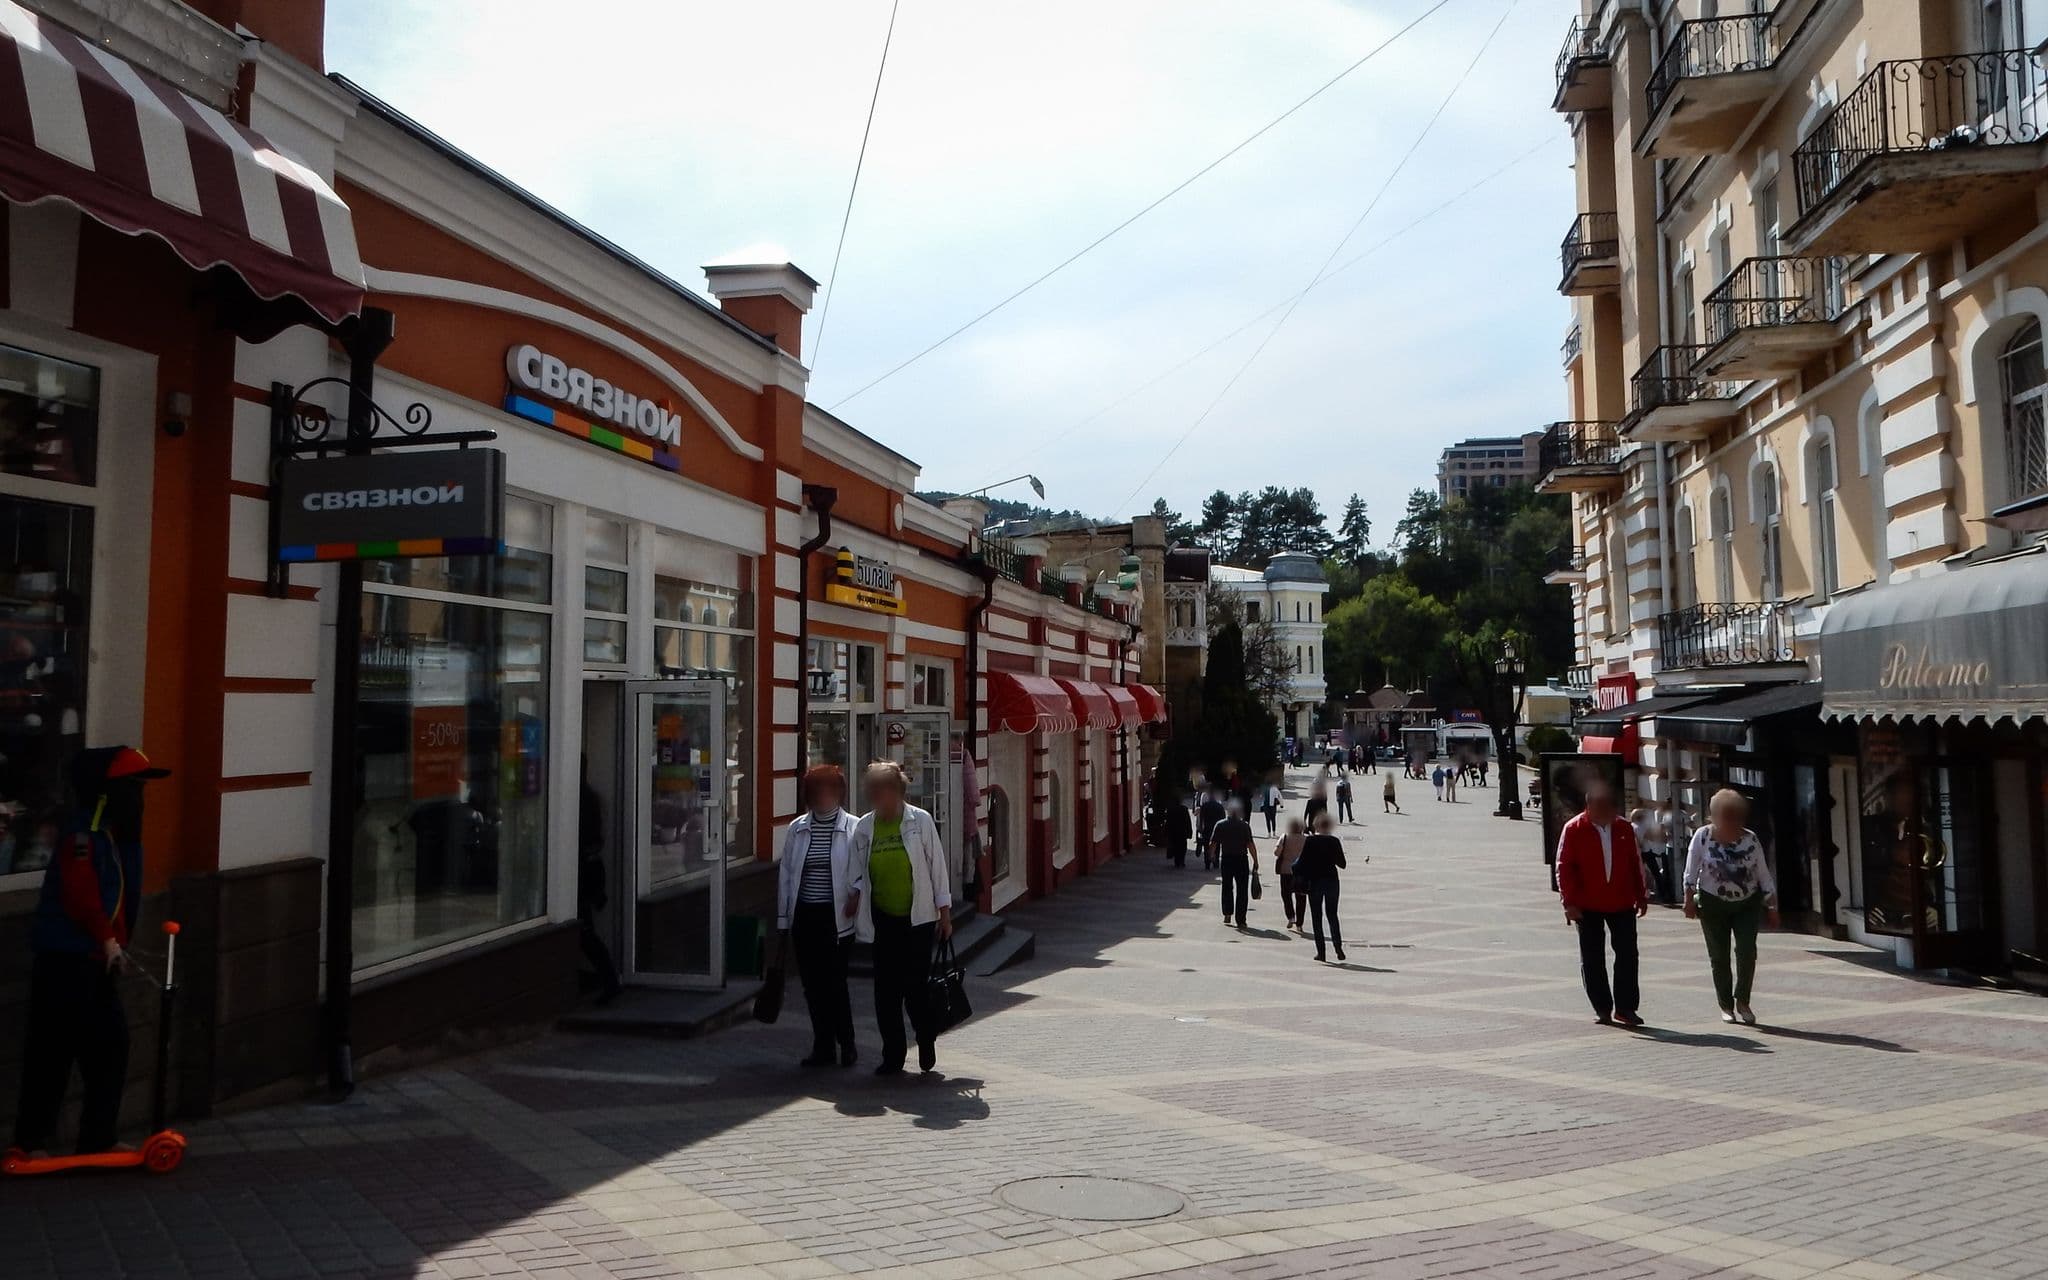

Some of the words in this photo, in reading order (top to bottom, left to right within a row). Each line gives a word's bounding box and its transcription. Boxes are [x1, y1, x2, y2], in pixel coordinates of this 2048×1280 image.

[507, 344, 682, 447] СВЯЗНОЙ
[302, 480, 464, 511] СВЯЗНОЙ
[1879, 643, 1991, 689] Palermo
[1599, 686, 1629, 711] ОПТИКА
